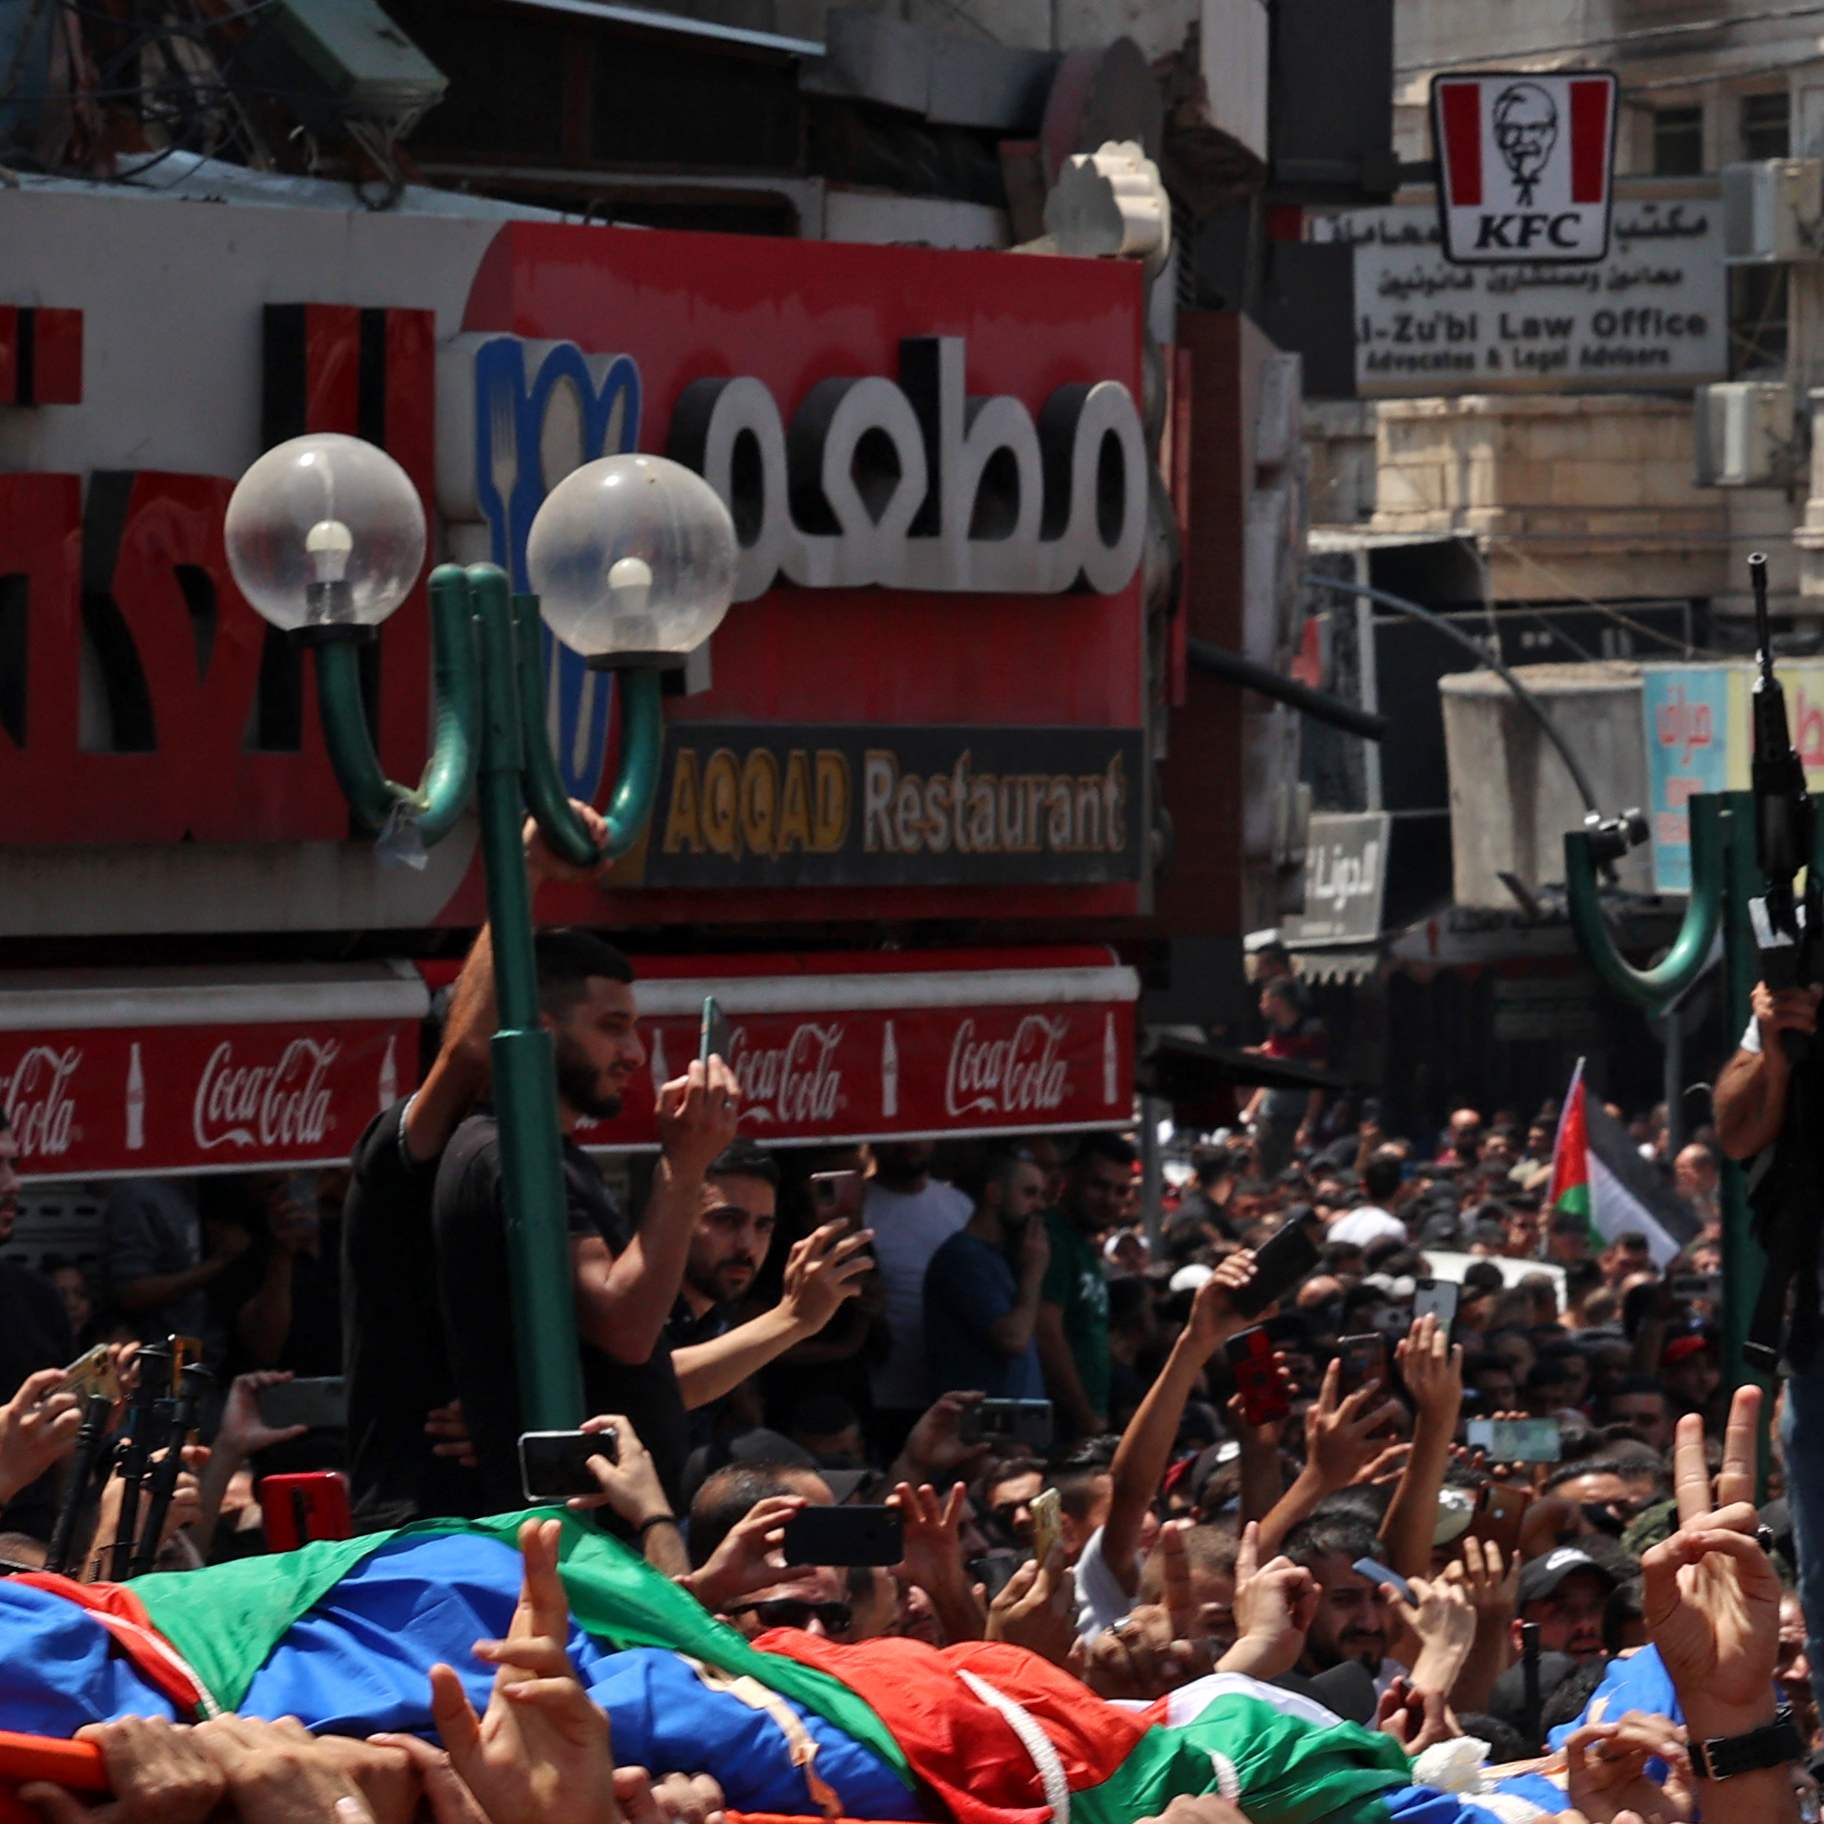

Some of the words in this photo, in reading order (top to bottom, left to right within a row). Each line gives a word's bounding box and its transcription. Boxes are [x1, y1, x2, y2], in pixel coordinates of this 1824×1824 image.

[1474, 213, 1581, 249] KFC
[1613, 205, 1708, 253] مكتب
[1356, 312, 1476, 344] l-Zu'bi
[1499, 312, 1573, 341] Law
[1591, 307, 1708, 339] Office
[1366, 349, 1475, 371] Advocates
[1513, 348, 1569, 373] Legal
[662, 748, 851, 862] AQQAD
[862, 748, 1127, 854] Restaurant
[945, 1014, 1070, 1117] Coca-Cola
[193, 1036, 343, 1150] Coca-Cola
